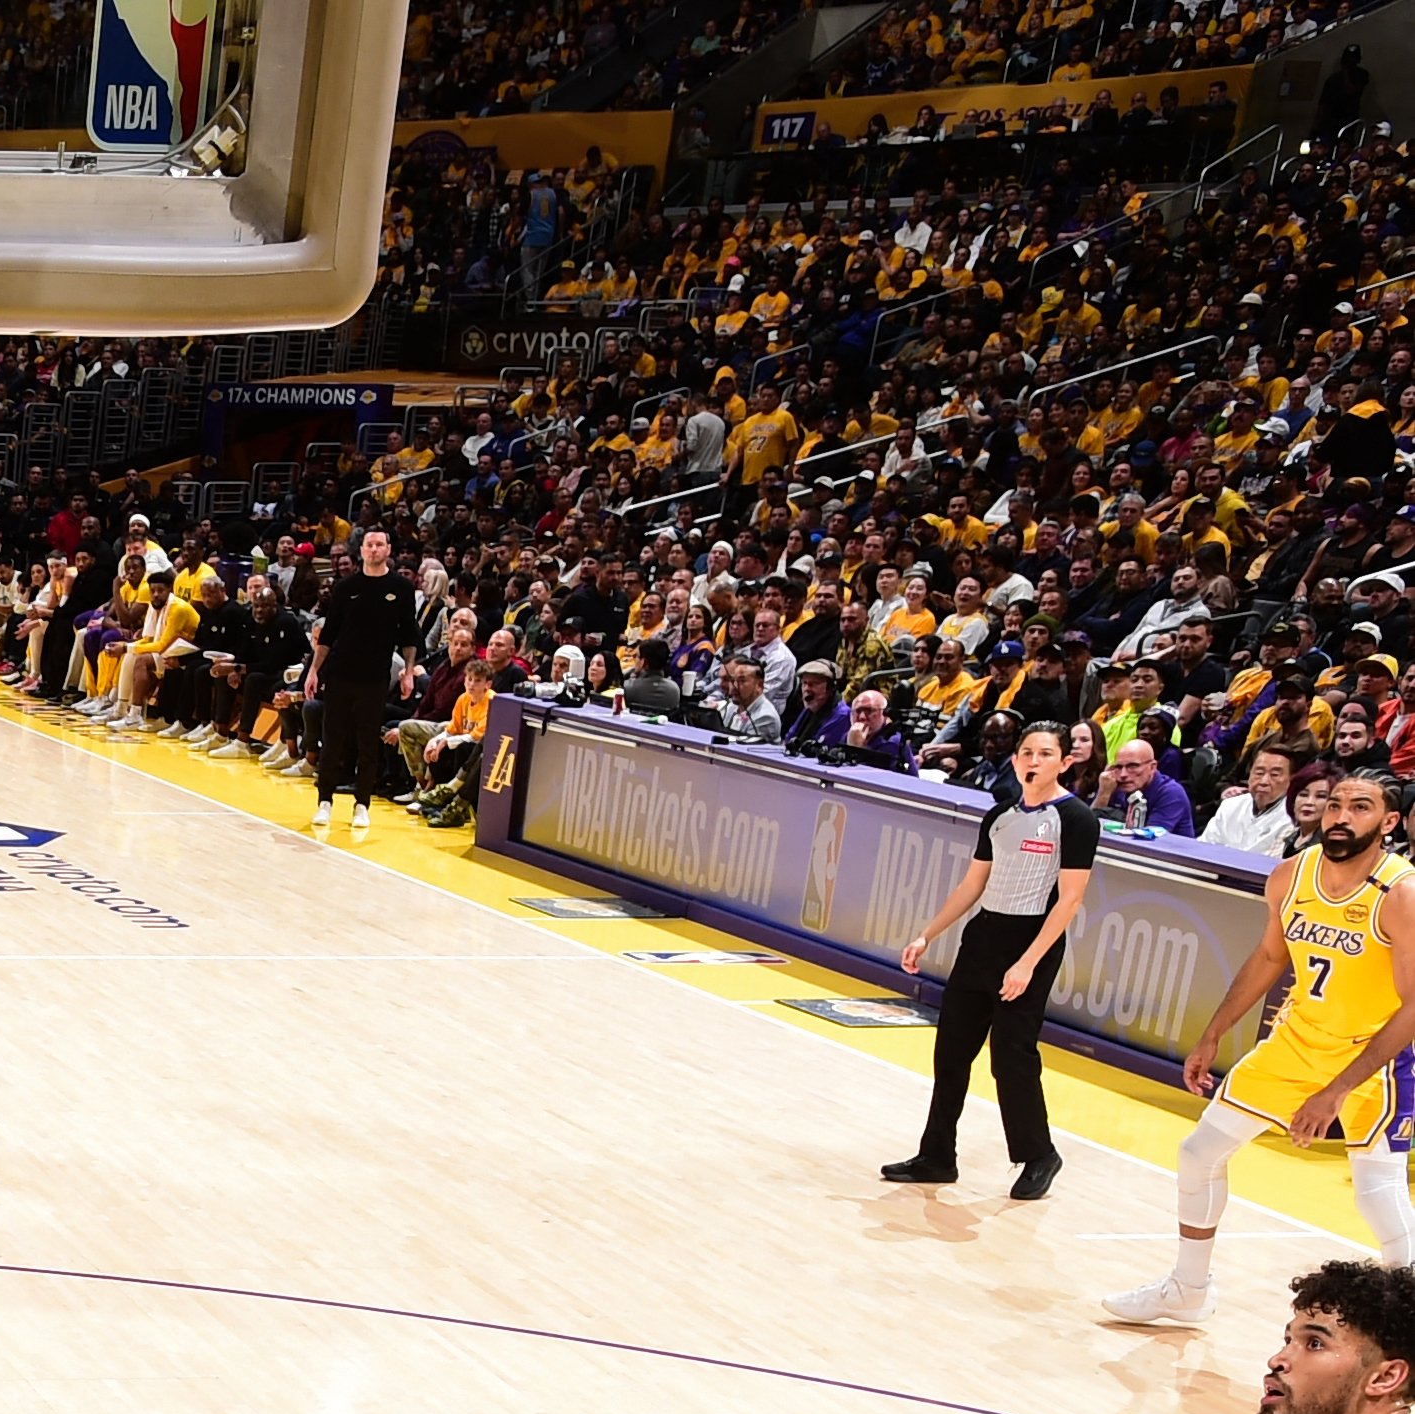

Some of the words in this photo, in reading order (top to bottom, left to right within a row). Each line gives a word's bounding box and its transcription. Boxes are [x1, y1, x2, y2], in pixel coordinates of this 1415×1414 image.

[104, 84, 158, 130] NBA
[771, 116, 806, 139] 117
[227, 387, 252, 403] 17x
[254, 387, 357, 405] CHAMPIONS
[556, 744, 780, 909] NBATickets.com
[7, 851, 190, 930] crypto.com
[862, 823, 1200, 1043] NBATs.com
[1284, 911, 1364, 956] LAKERS
[1307, 954, 1333, 1001] 7
